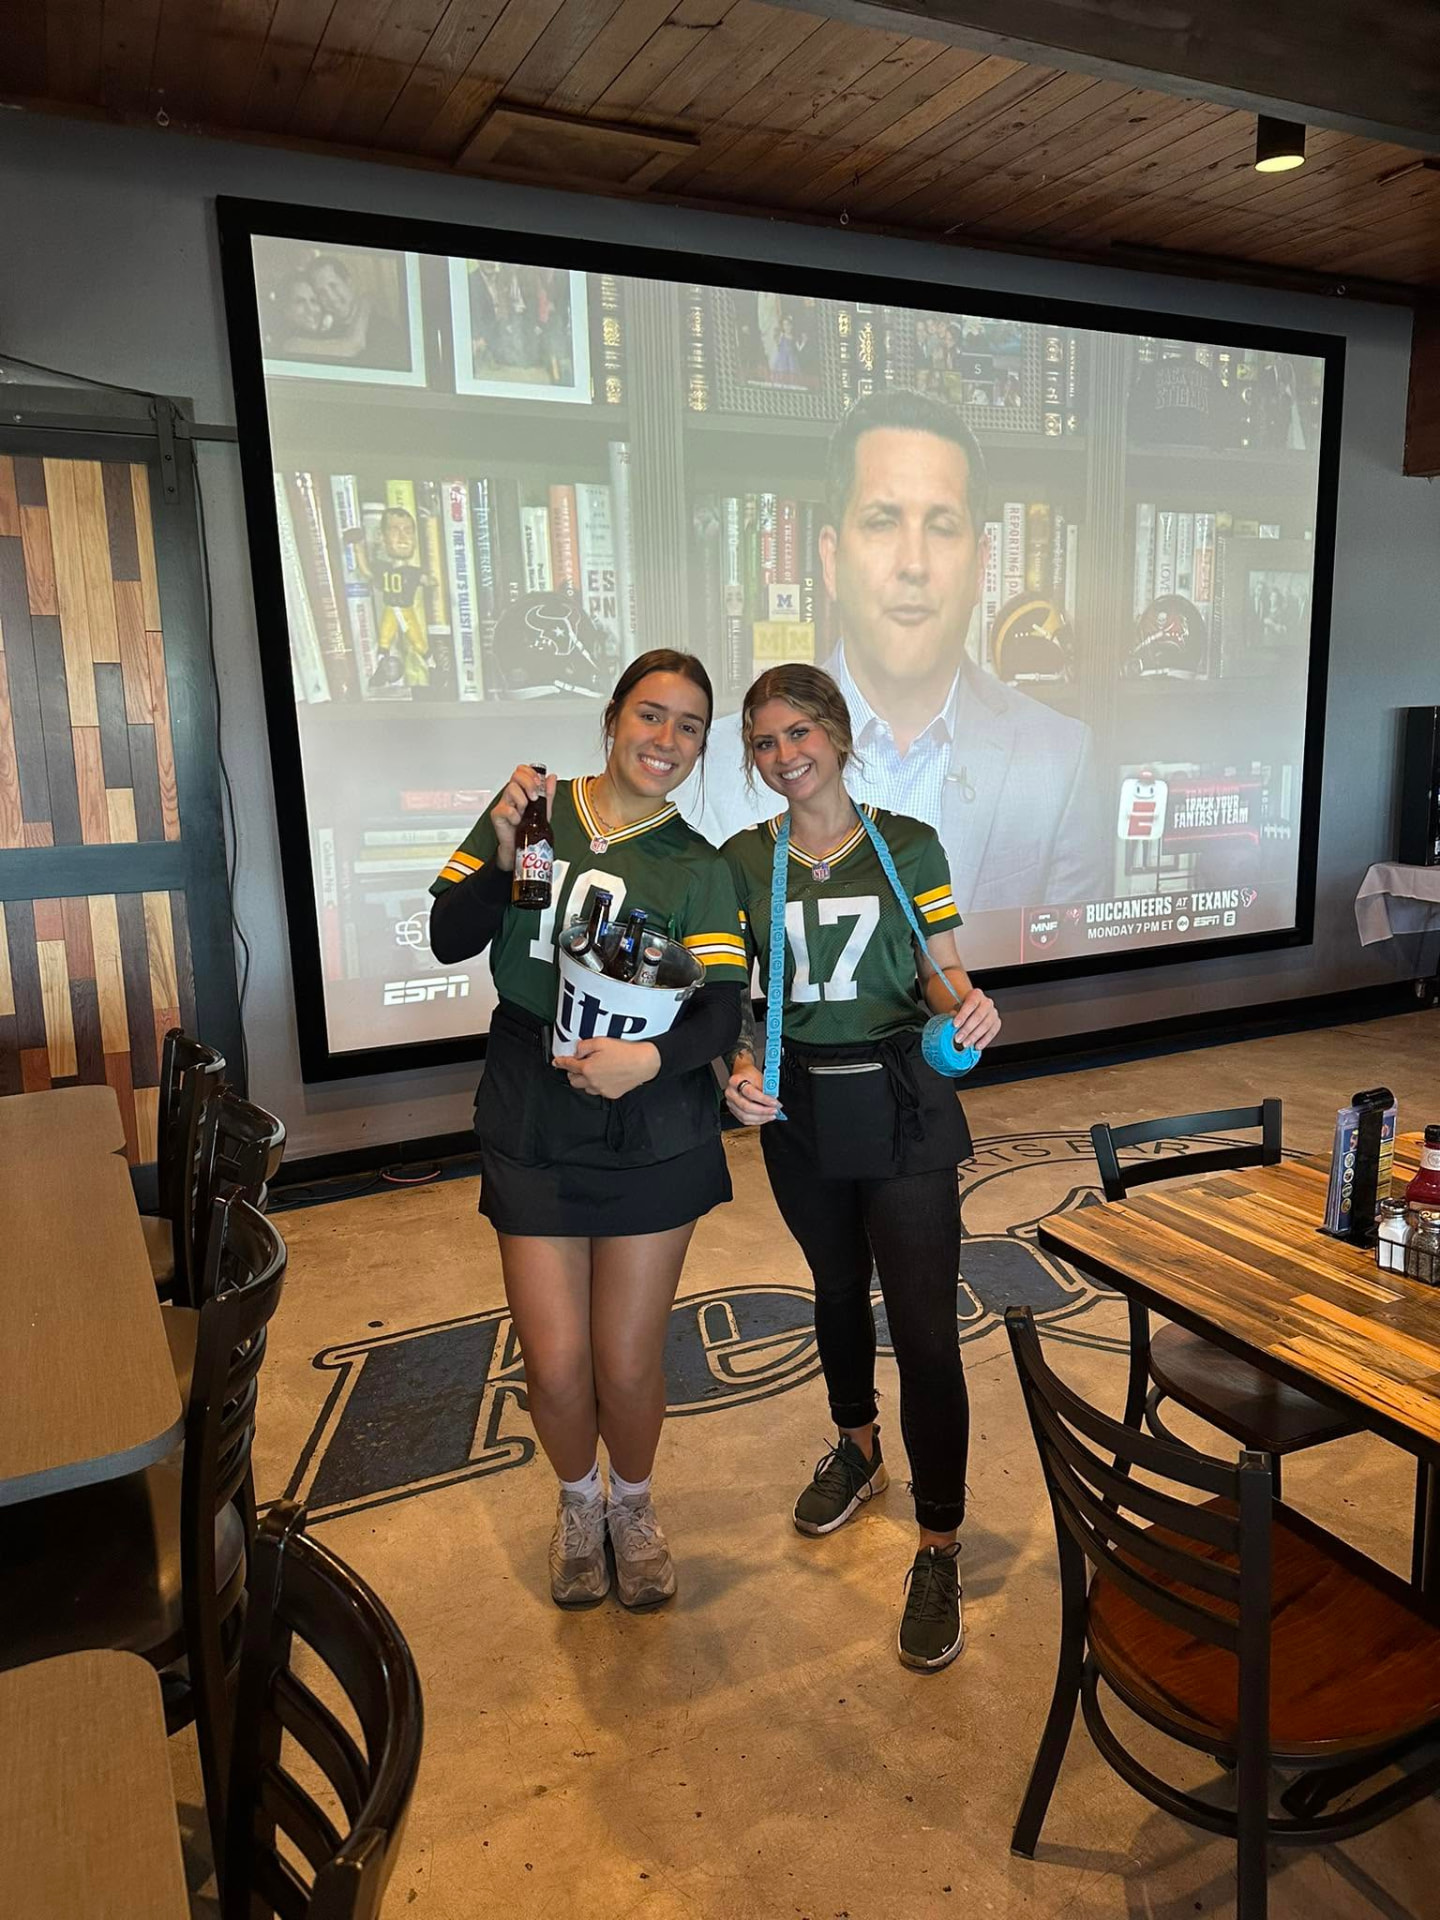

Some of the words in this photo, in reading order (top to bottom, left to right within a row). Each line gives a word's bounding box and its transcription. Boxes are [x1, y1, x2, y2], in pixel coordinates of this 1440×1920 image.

[974, 364, 982, 375] S
[1008, 507, 1020, 573] REPORTING
[477, 529, 493, 589] MURRAY
[383, 571, 402, 593] 10
[1160, 563, 1171, 592] LOVE
[776, 593, 793, 608] M
[1185, 796, 1214, 812] TRACK
[1216, 794, 1239, 810] YOUR
[1174, 809, 1219, 829] FANTASY
[1221, 807, 1248, 825] TEAM
[522, 852, 553, 870] Coo
[526, 869, 551, 879] LIGH
[1086, 896, 1172, 924] BUCCANEERS
[1175, 896, 1189, 908] AT
[1191, 889, 1239, 912] TEXANS
[1030, 920, 1059, 934] MNF
[1087, 923, 1134, 939] MONDAY
[1136, 922, 1142, 934] 7
[1143, 920, 1160, 933] PM
[1161, 919, 1174, 931] ET
[1193, 914, 1220, 927] ESPN
[785, 895, 880, 1003] 17
[383, 974, 470, 1006] ESPN
[555, 977, 648, 1042] ite
